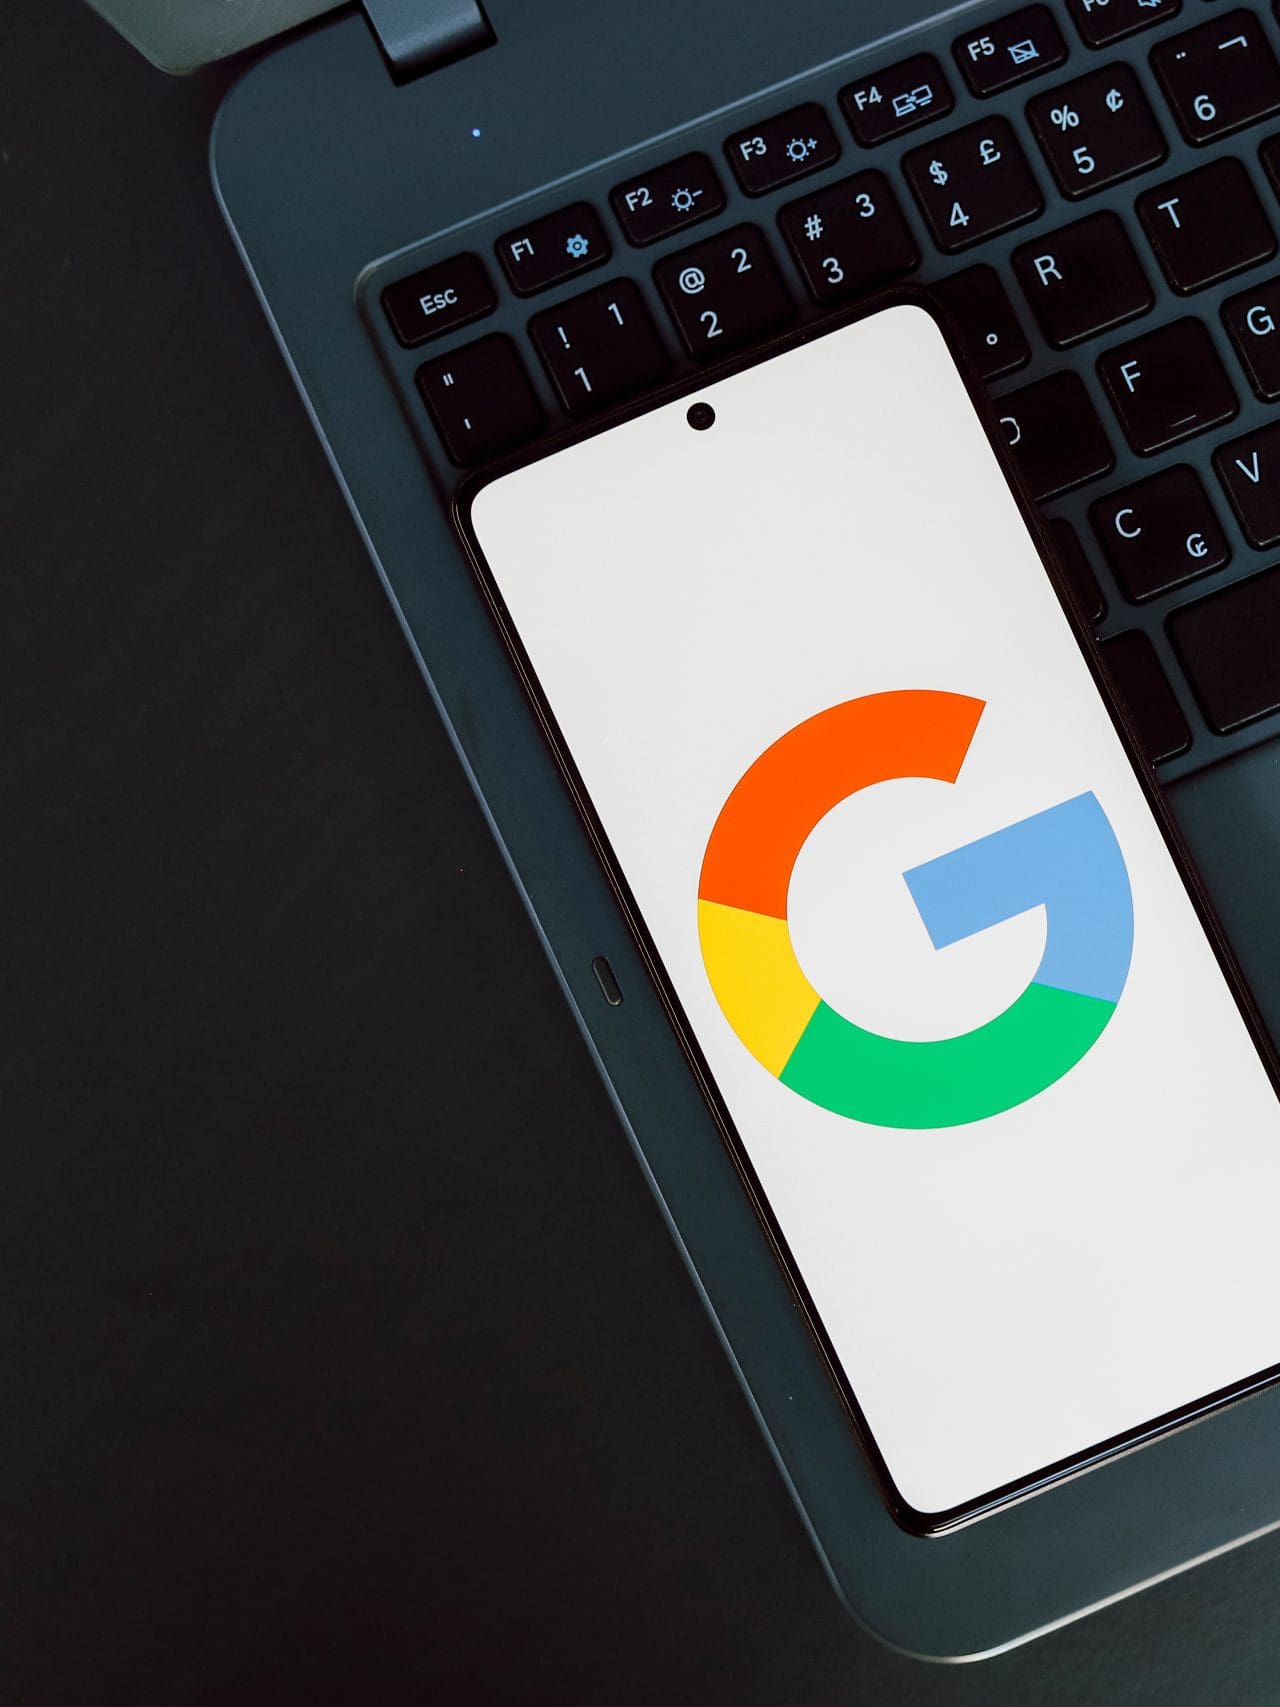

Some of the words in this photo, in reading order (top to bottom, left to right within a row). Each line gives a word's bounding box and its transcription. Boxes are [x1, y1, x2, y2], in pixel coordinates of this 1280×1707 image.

[968, 37, 994, 60] F5
[855, 87, 882, 110] F4
[1106, 89, 1123, 112] ¢
[1194, 95, 1215, 120] 6
[1051, 105, 1080, 130] %
[740, 137, 766, 160] F3
[980, 139, 1000, 165] £
[1073, 147, 1094, 173] 5
[929, 160, 948, 185] $
[626, 188, 652, 211] F2
[856, 194, 874, 217] 3
[949, 203, 969, 226] 4
[1158, 199, 1180, 228] T
[805, 215, 823, 240] #
[511, 238, 533, 260] F1
[732, 248, 751, 273] 2
[680, 267, 704, 293] @
[823, 257, 843, 283] 3
[1034, 255, 1062, 285] R
[420, 289, 457, 314] Esc
[608, 303, 623, 325] 1
[701, 311, 722, 338] 2
[1246, 305, 1274, 335] G
[558, 326, 570, 349] !
[575, 367, 592, 392] 1
[1121, 360, 1141, 392] F
[1236, 452, 1260, 483] V
[1116, 508, 1141, 538] C
[697, 690, 1134, 1129] G
